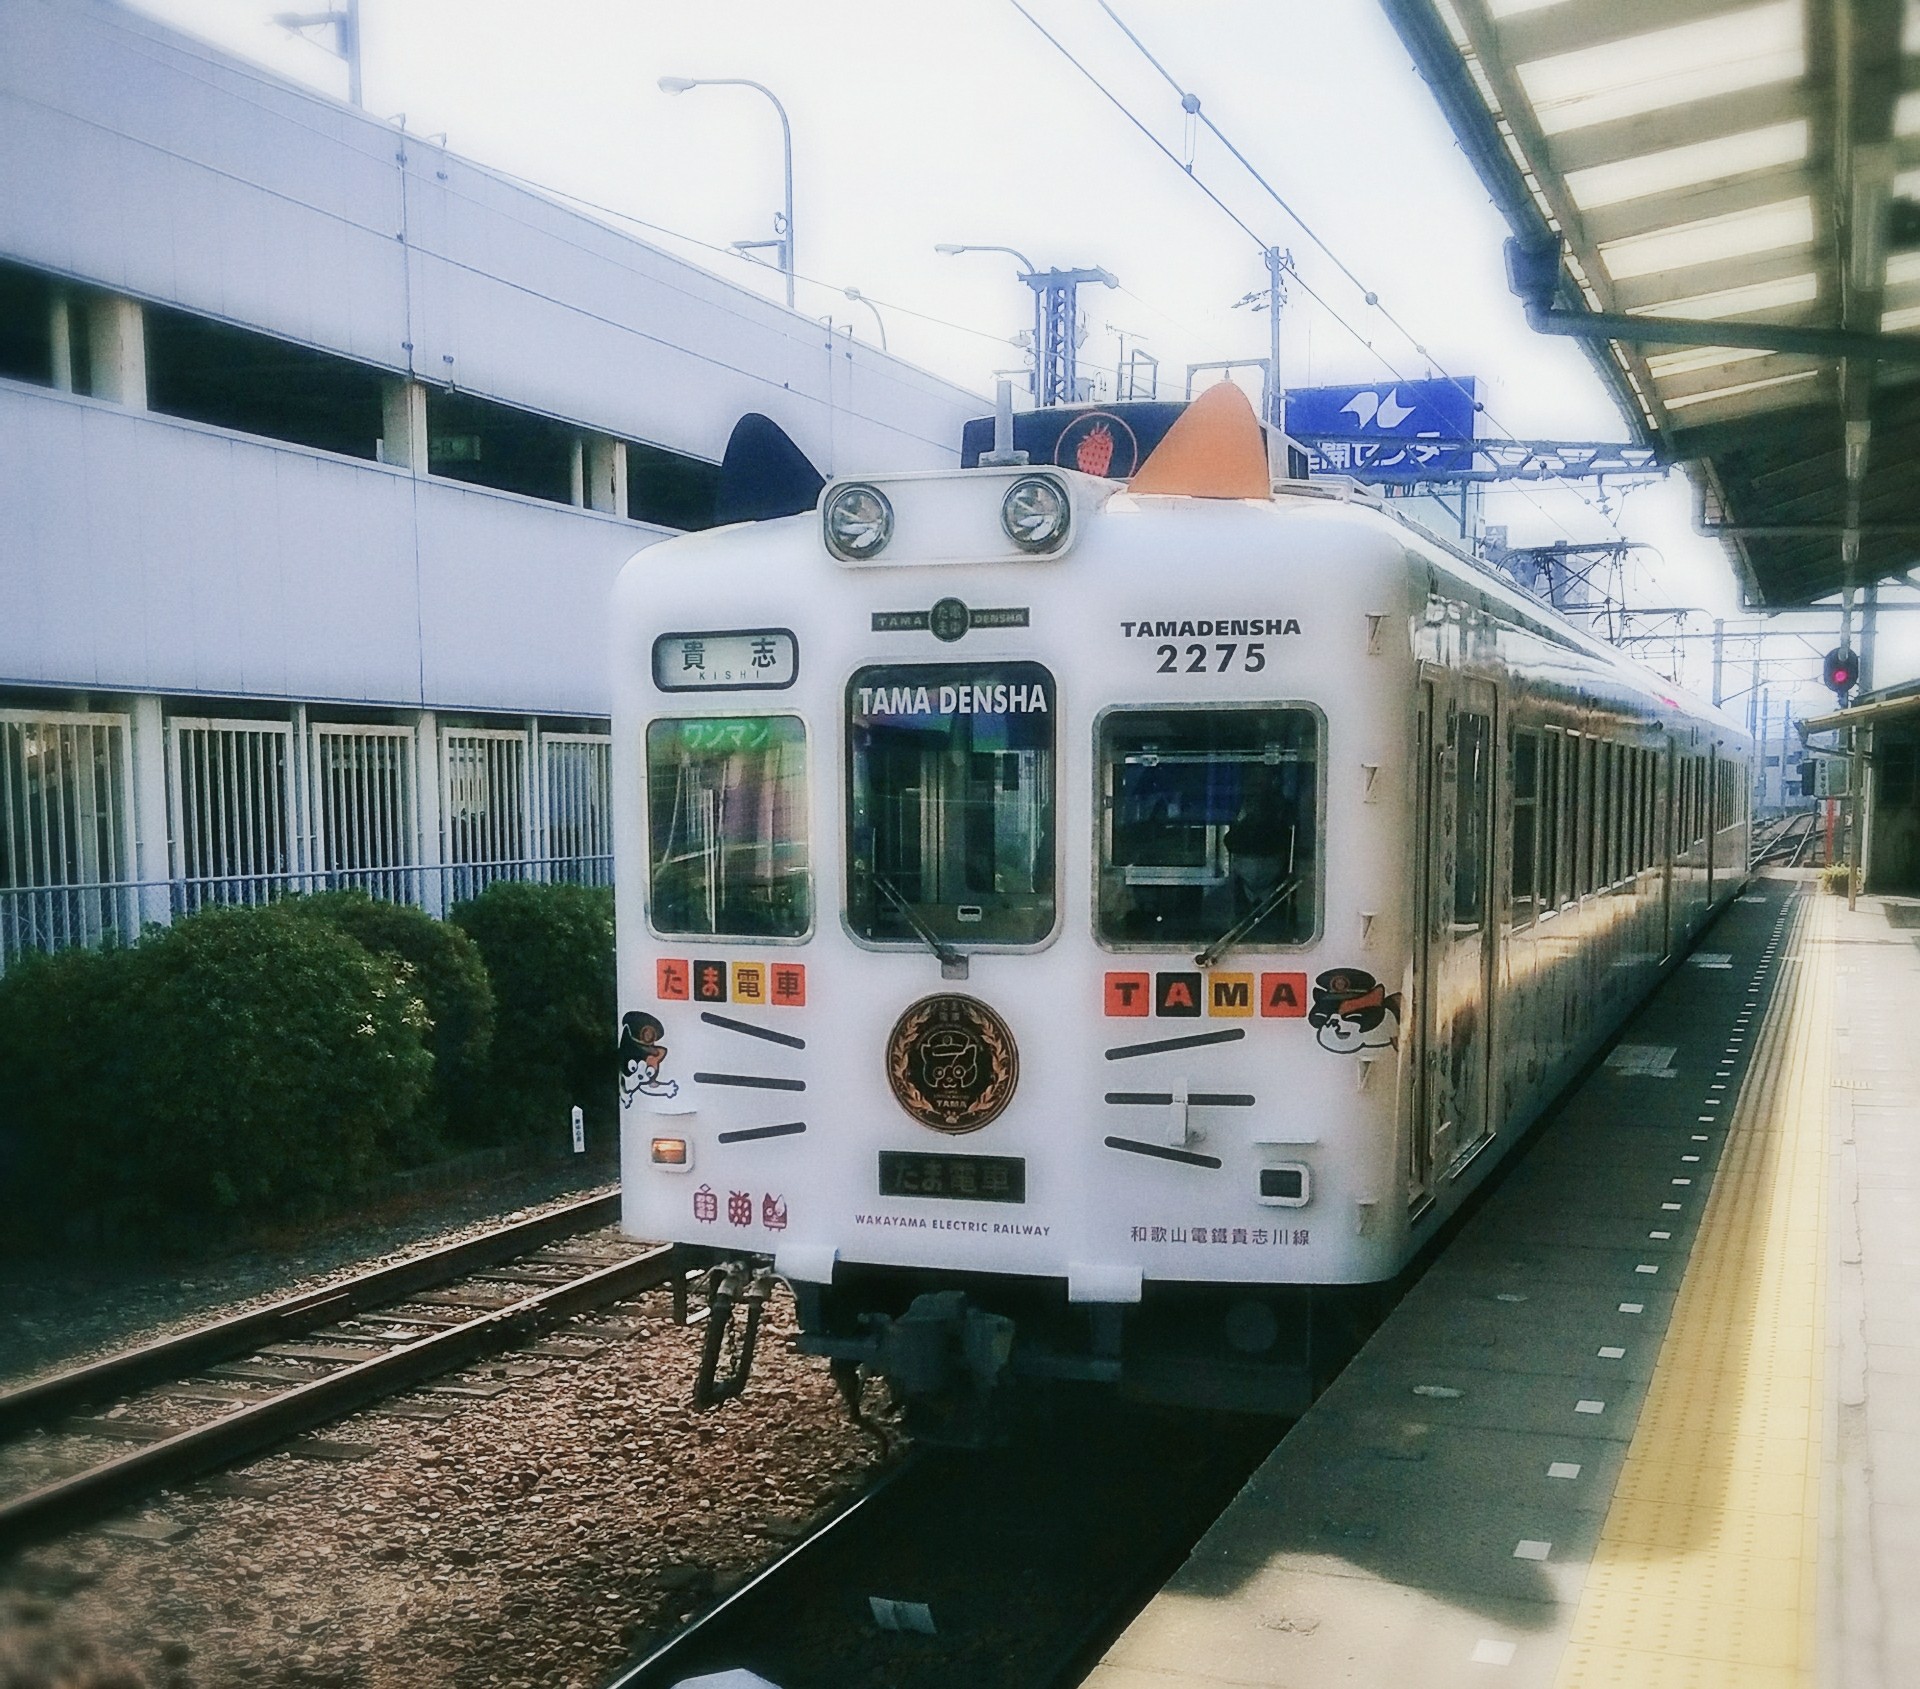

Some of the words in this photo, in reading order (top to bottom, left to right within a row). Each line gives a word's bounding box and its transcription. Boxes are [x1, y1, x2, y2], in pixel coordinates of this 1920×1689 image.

[878, 616, 923, 627] TAMA
[974, 613, 1024, 624] DENSHA
[1121, 619, 1301, 638] TAMADENSHA
[1156, 643, 1266, 674] 2275
[699, 669, 760, 681] KISHI
[859, 686, 931, 716] TAMA
[939, 684, 1048, 714] DENSHA
[683, 722, 769, 748] ワンマン
[661, 964, 801, 998] たま電車
[1113, 980, 1299, 1009] TAMA
[855, 1214, 927, 1229] WAKAYAMA
[932, 1219, 988, 1233] ELECTRIC
[993, 1223, 1051, 1236] RAILWAY
[1130, 1225, 1310, 1246] 和歌山電鐵貴志川線
